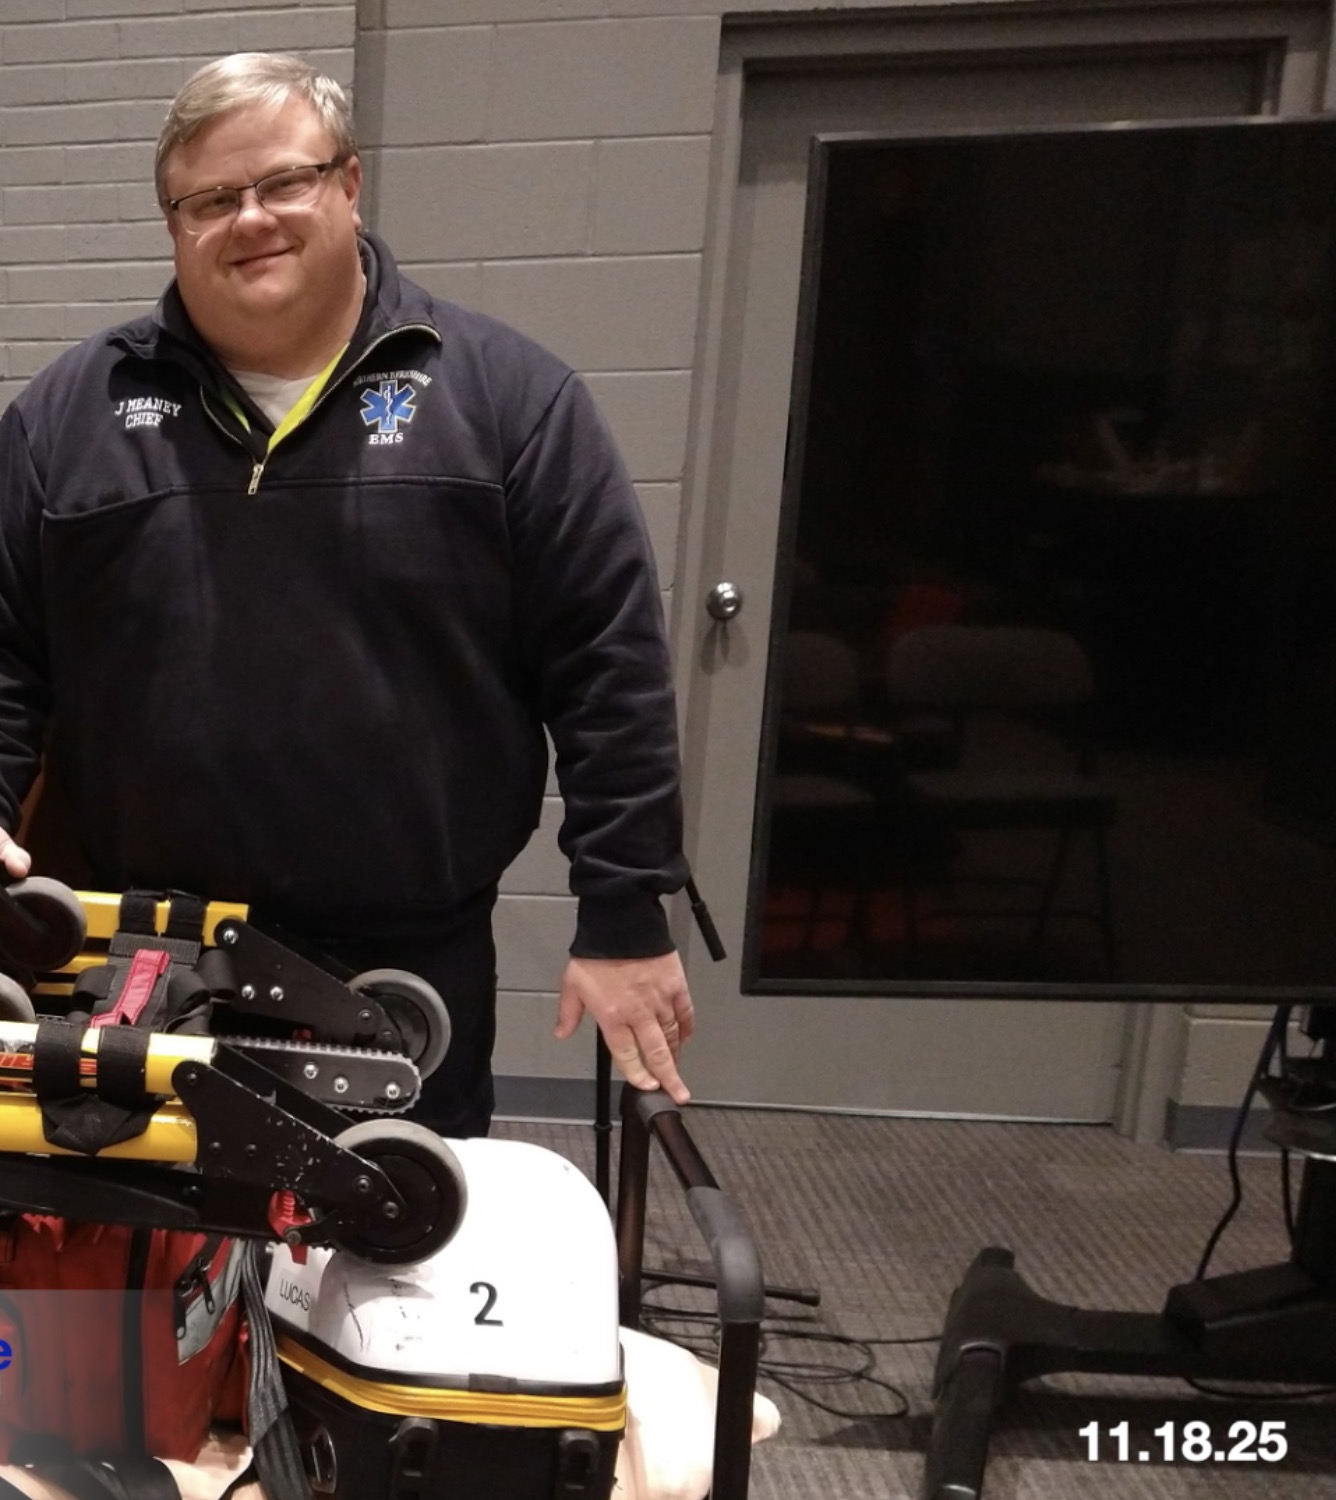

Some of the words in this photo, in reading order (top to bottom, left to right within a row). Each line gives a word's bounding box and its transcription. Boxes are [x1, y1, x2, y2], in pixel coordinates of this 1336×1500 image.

[114, 402, 124, 415] J
[126, 397, 182, 417] MEANEY
[125, 411, 163, 429] CHIEF
[368, 433, 404, 445] EMS
[280, 1278, 311, 1311] LUCAS
[469, 1281, 504, 1327] 2
